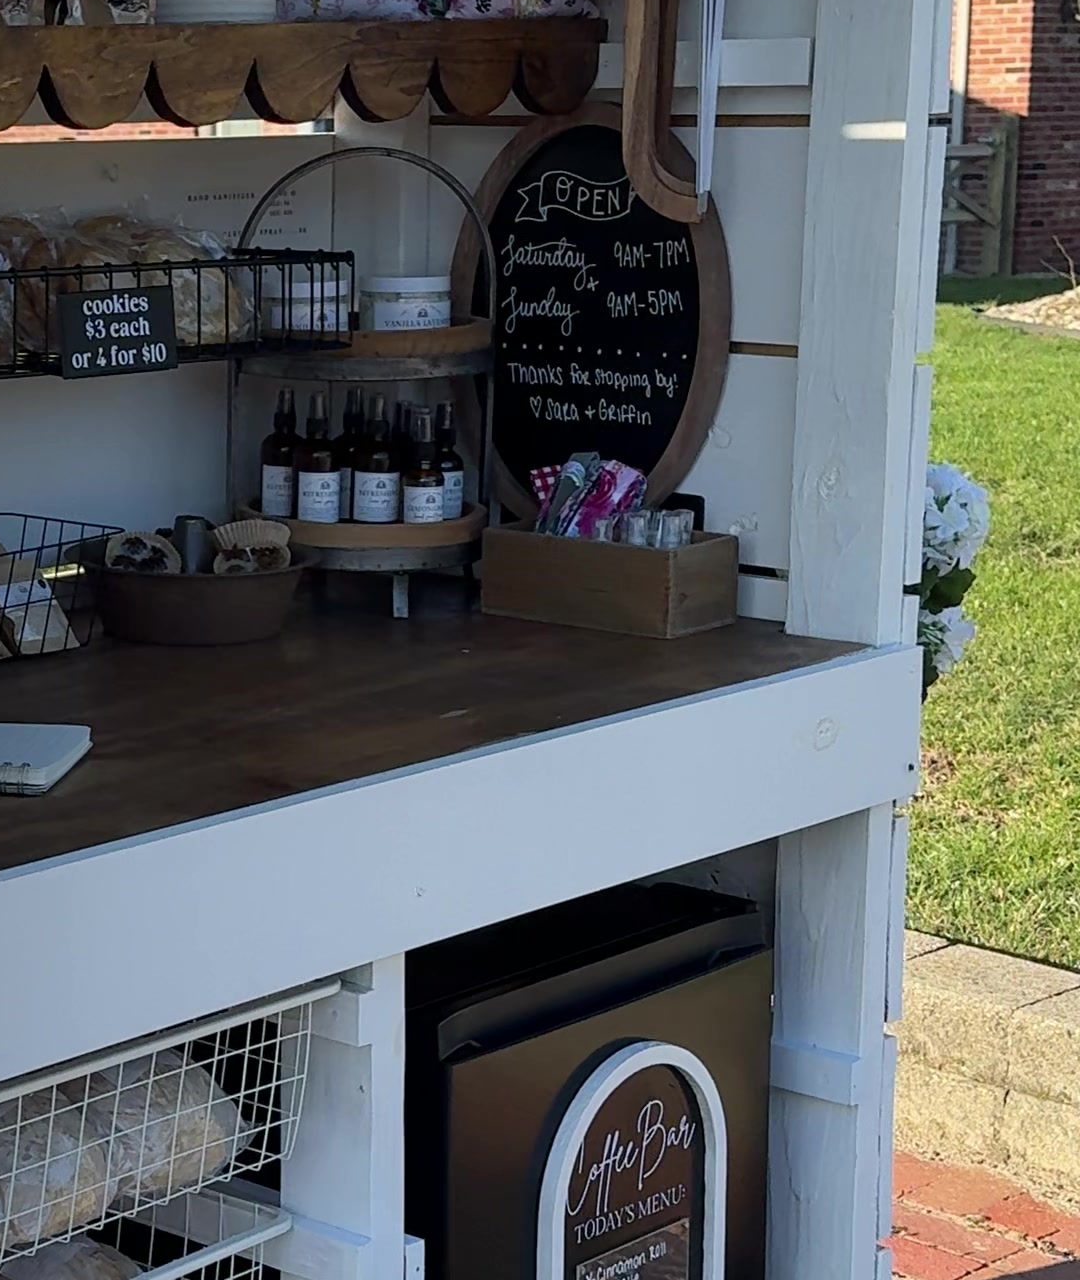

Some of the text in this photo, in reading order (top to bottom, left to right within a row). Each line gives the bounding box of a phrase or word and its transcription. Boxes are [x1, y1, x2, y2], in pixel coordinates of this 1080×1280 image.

[555, 176, 622, 217] OPEN
[501, 233, 598, 292] Saturday
[82, 293, 150, 317] cookies
[501, 286, 581, 337] Sunday
[85, 316, 151, 341] $3 each
[71, 341, 168, 369] or 4 for $10
[507, 362, 563, 386] Thanks
[594, 367, 653, 399] stopping
[655, 368, 679, 399] by!
[566, 1099, 697, 1217] Coffee Bar
[574, 1183, 687, 1245] TODAY'S MENU:
[648, 1240, 668, 1260] Roll
